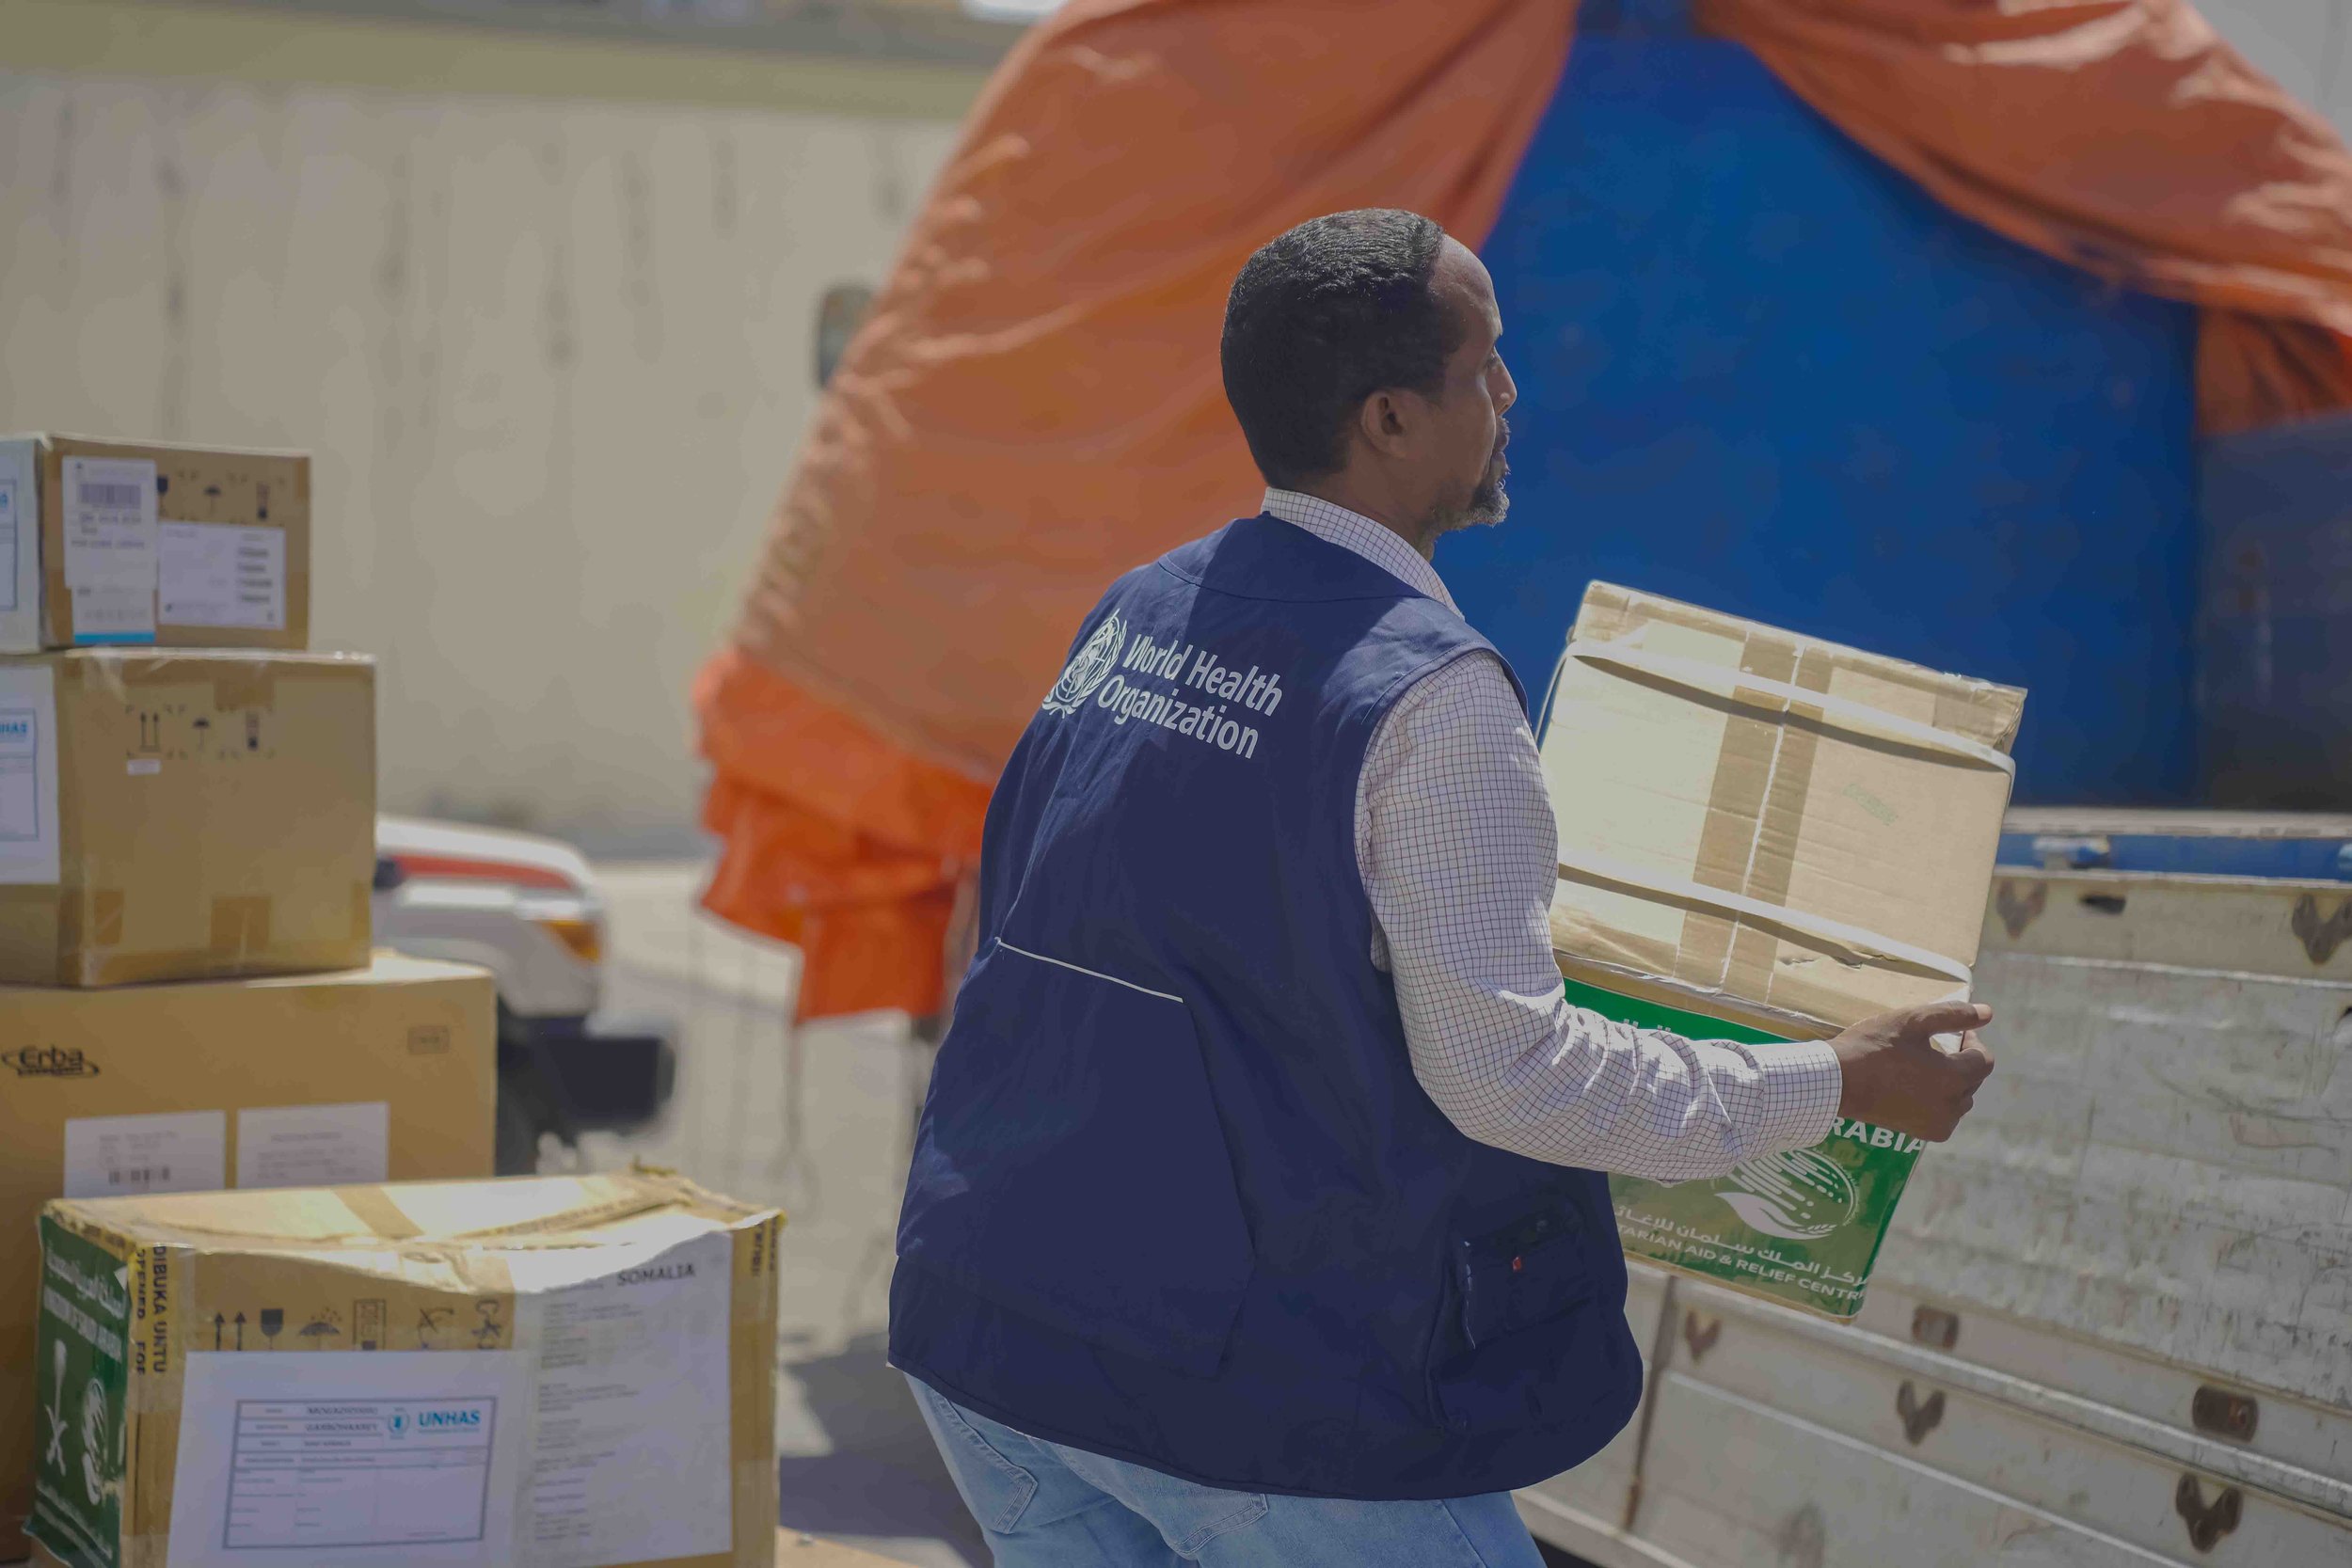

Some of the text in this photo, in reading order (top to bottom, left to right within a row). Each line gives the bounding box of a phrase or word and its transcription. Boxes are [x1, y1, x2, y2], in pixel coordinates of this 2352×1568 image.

[1122, 633, 1283, 717] World Health
[1097, 674, 1259, 759] Organization
[19, 1045, 84, 1069] Erba
[1833, 1117, 1926, 1154] RABIA
[1677, 1226, 1755, 1254] سلمان
[617, 1263, 696, 1286] SOMALIA
[1619, 1225, 1863, 1300] TARIAN AID & RELIEF CENTR
[1757, 1249, 1820, 1274] الملك
[153, 1246, 167, 1373] DIBUKA UNTU
[418, 1410, 481, 1428] UNHAS
